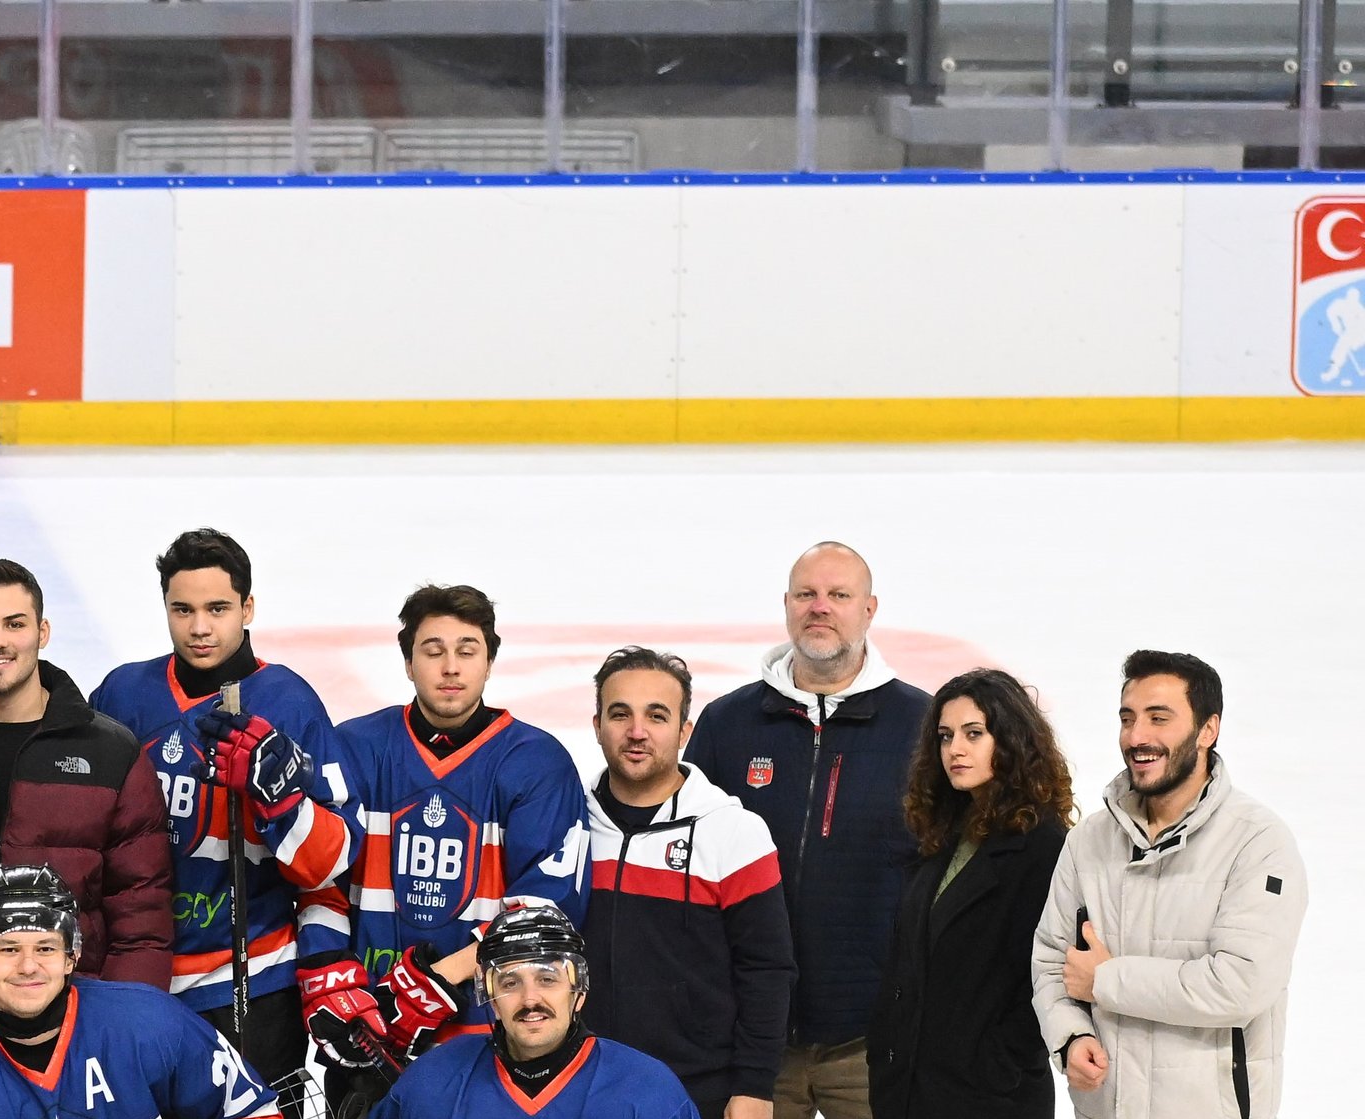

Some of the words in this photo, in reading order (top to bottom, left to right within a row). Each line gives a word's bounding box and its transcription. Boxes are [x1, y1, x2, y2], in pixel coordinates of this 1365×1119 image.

[55, 761, 78, 769] NORTH
[59, 766, 78, 774] FACE
[413, 881, 443, 895] SPOR
[503, 931, 541, 943] BAUER
[514, 1066, 551, 1081] BAUER
[85, 1057, 115, 1110] A
